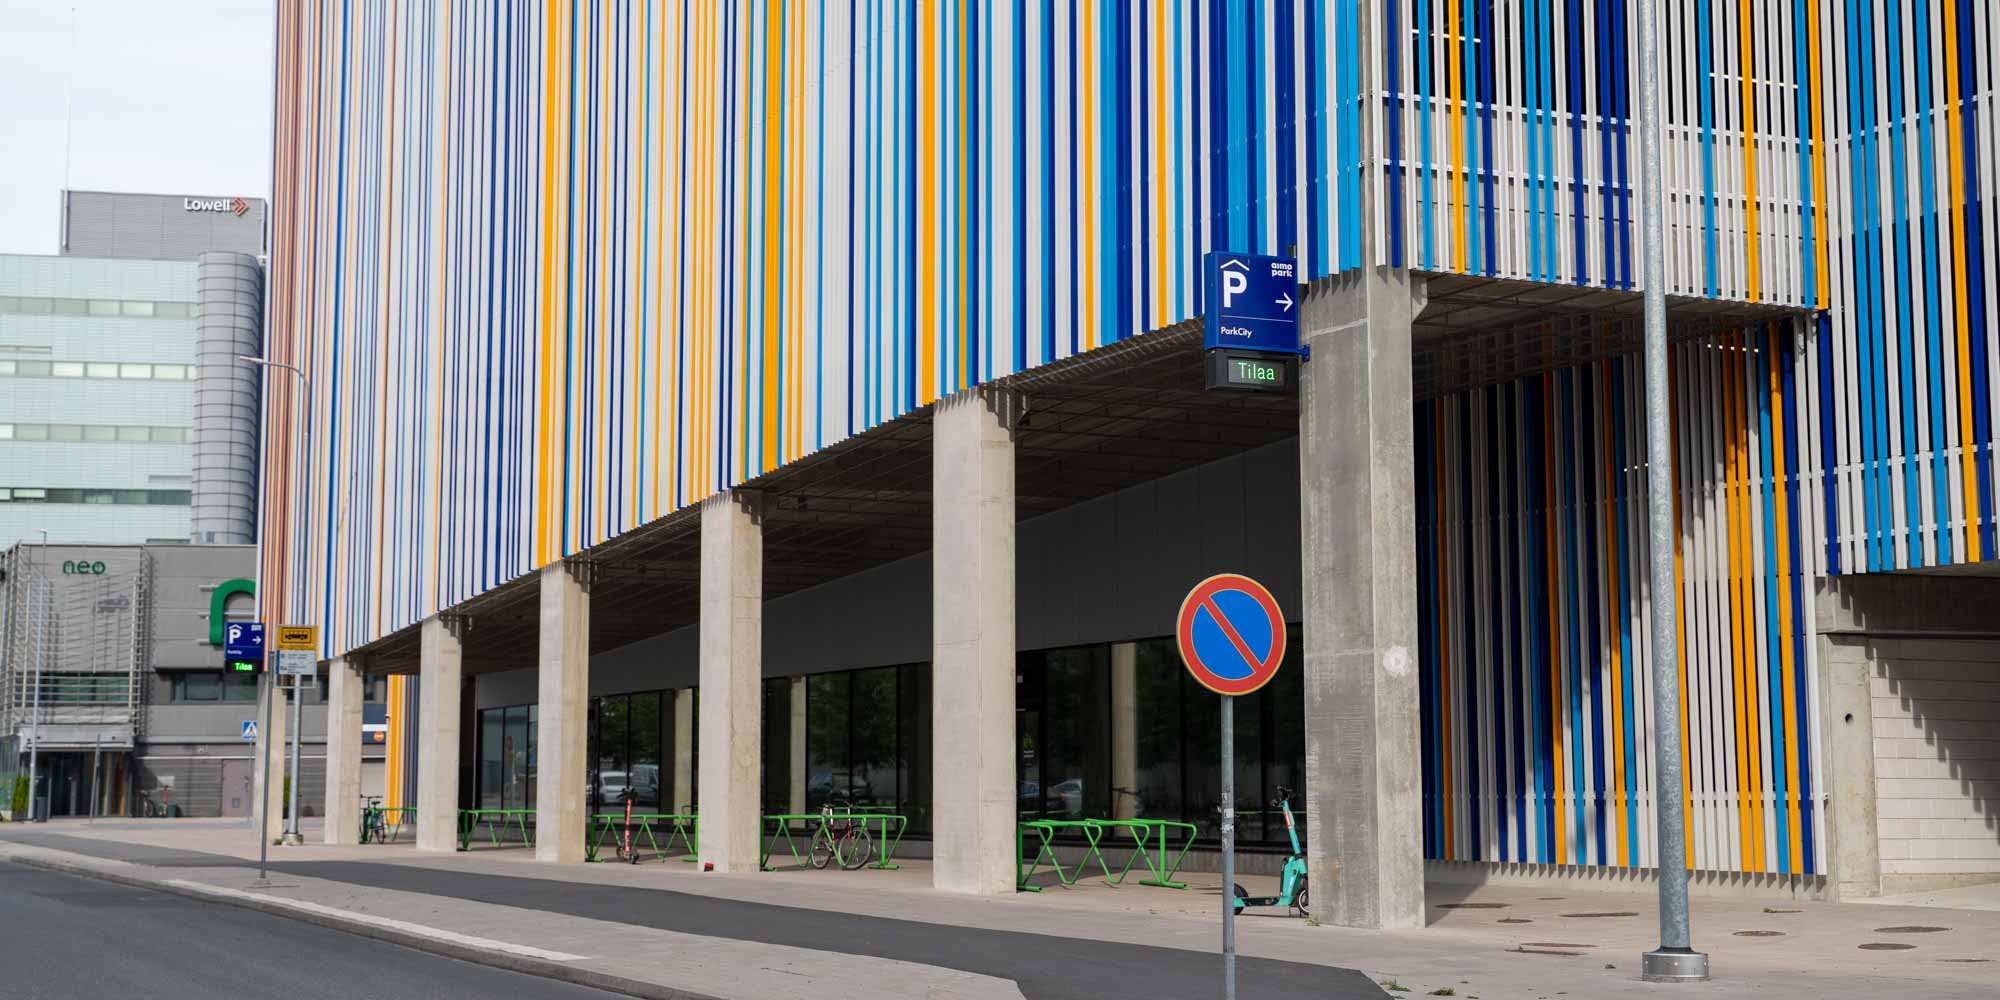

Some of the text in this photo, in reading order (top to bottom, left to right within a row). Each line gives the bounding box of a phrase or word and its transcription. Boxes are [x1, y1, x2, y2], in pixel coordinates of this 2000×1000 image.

[184, 198, 230, 211] Lowell
[1271, 262, 1293, 270] aimo
[1271, 269, 1293, 278] park
[1223, 271, 1247, 308] P
[1220, 326, 1253, 338] ParkCity
[1238, 362, 1275, 380] Tilaa
[63, 560, 106, 575] neo
[228, 629, 241, 644] P
